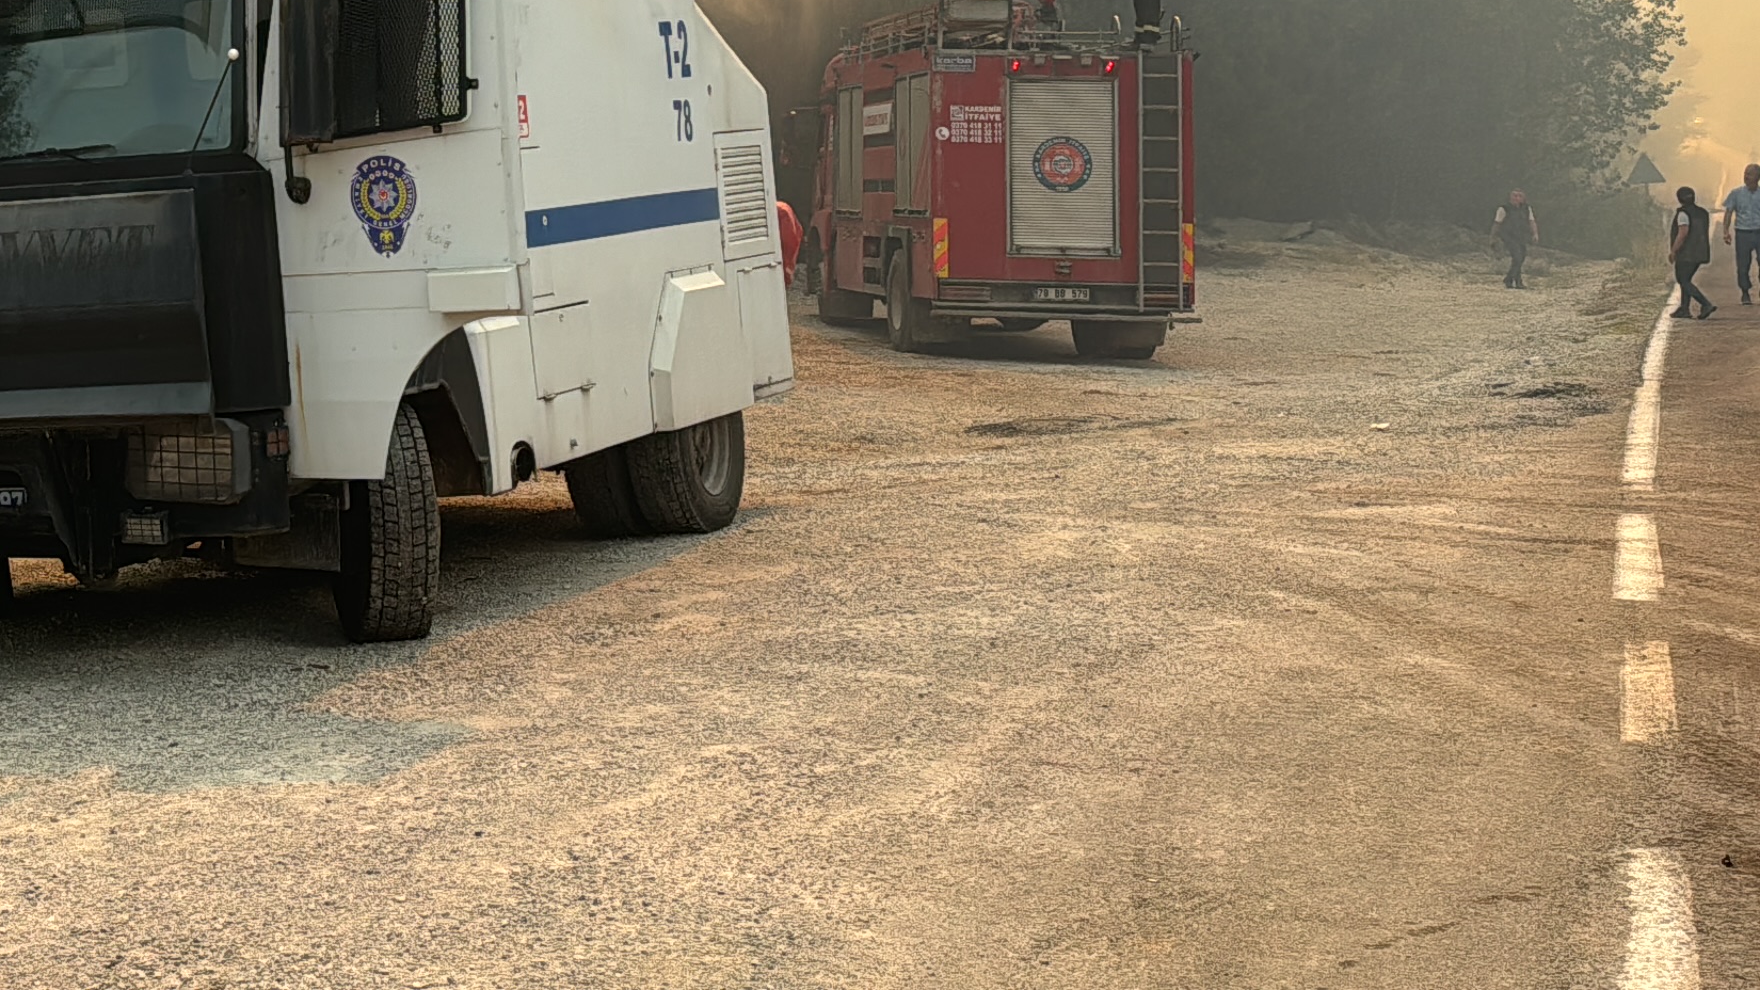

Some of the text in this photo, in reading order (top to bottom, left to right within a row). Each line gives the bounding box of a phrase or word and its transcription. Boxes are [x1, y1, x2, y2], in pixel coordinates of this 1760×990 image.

[658, 19, 692, 79] T-2
[672, 99, 693, 142] 78
[964, 112, 1002, 121] İTFAİYE
[950, 136, 968, 144] 0370
[361, 158, 401, 173] POLİS
[1071, 289, 1088, 299] 579
